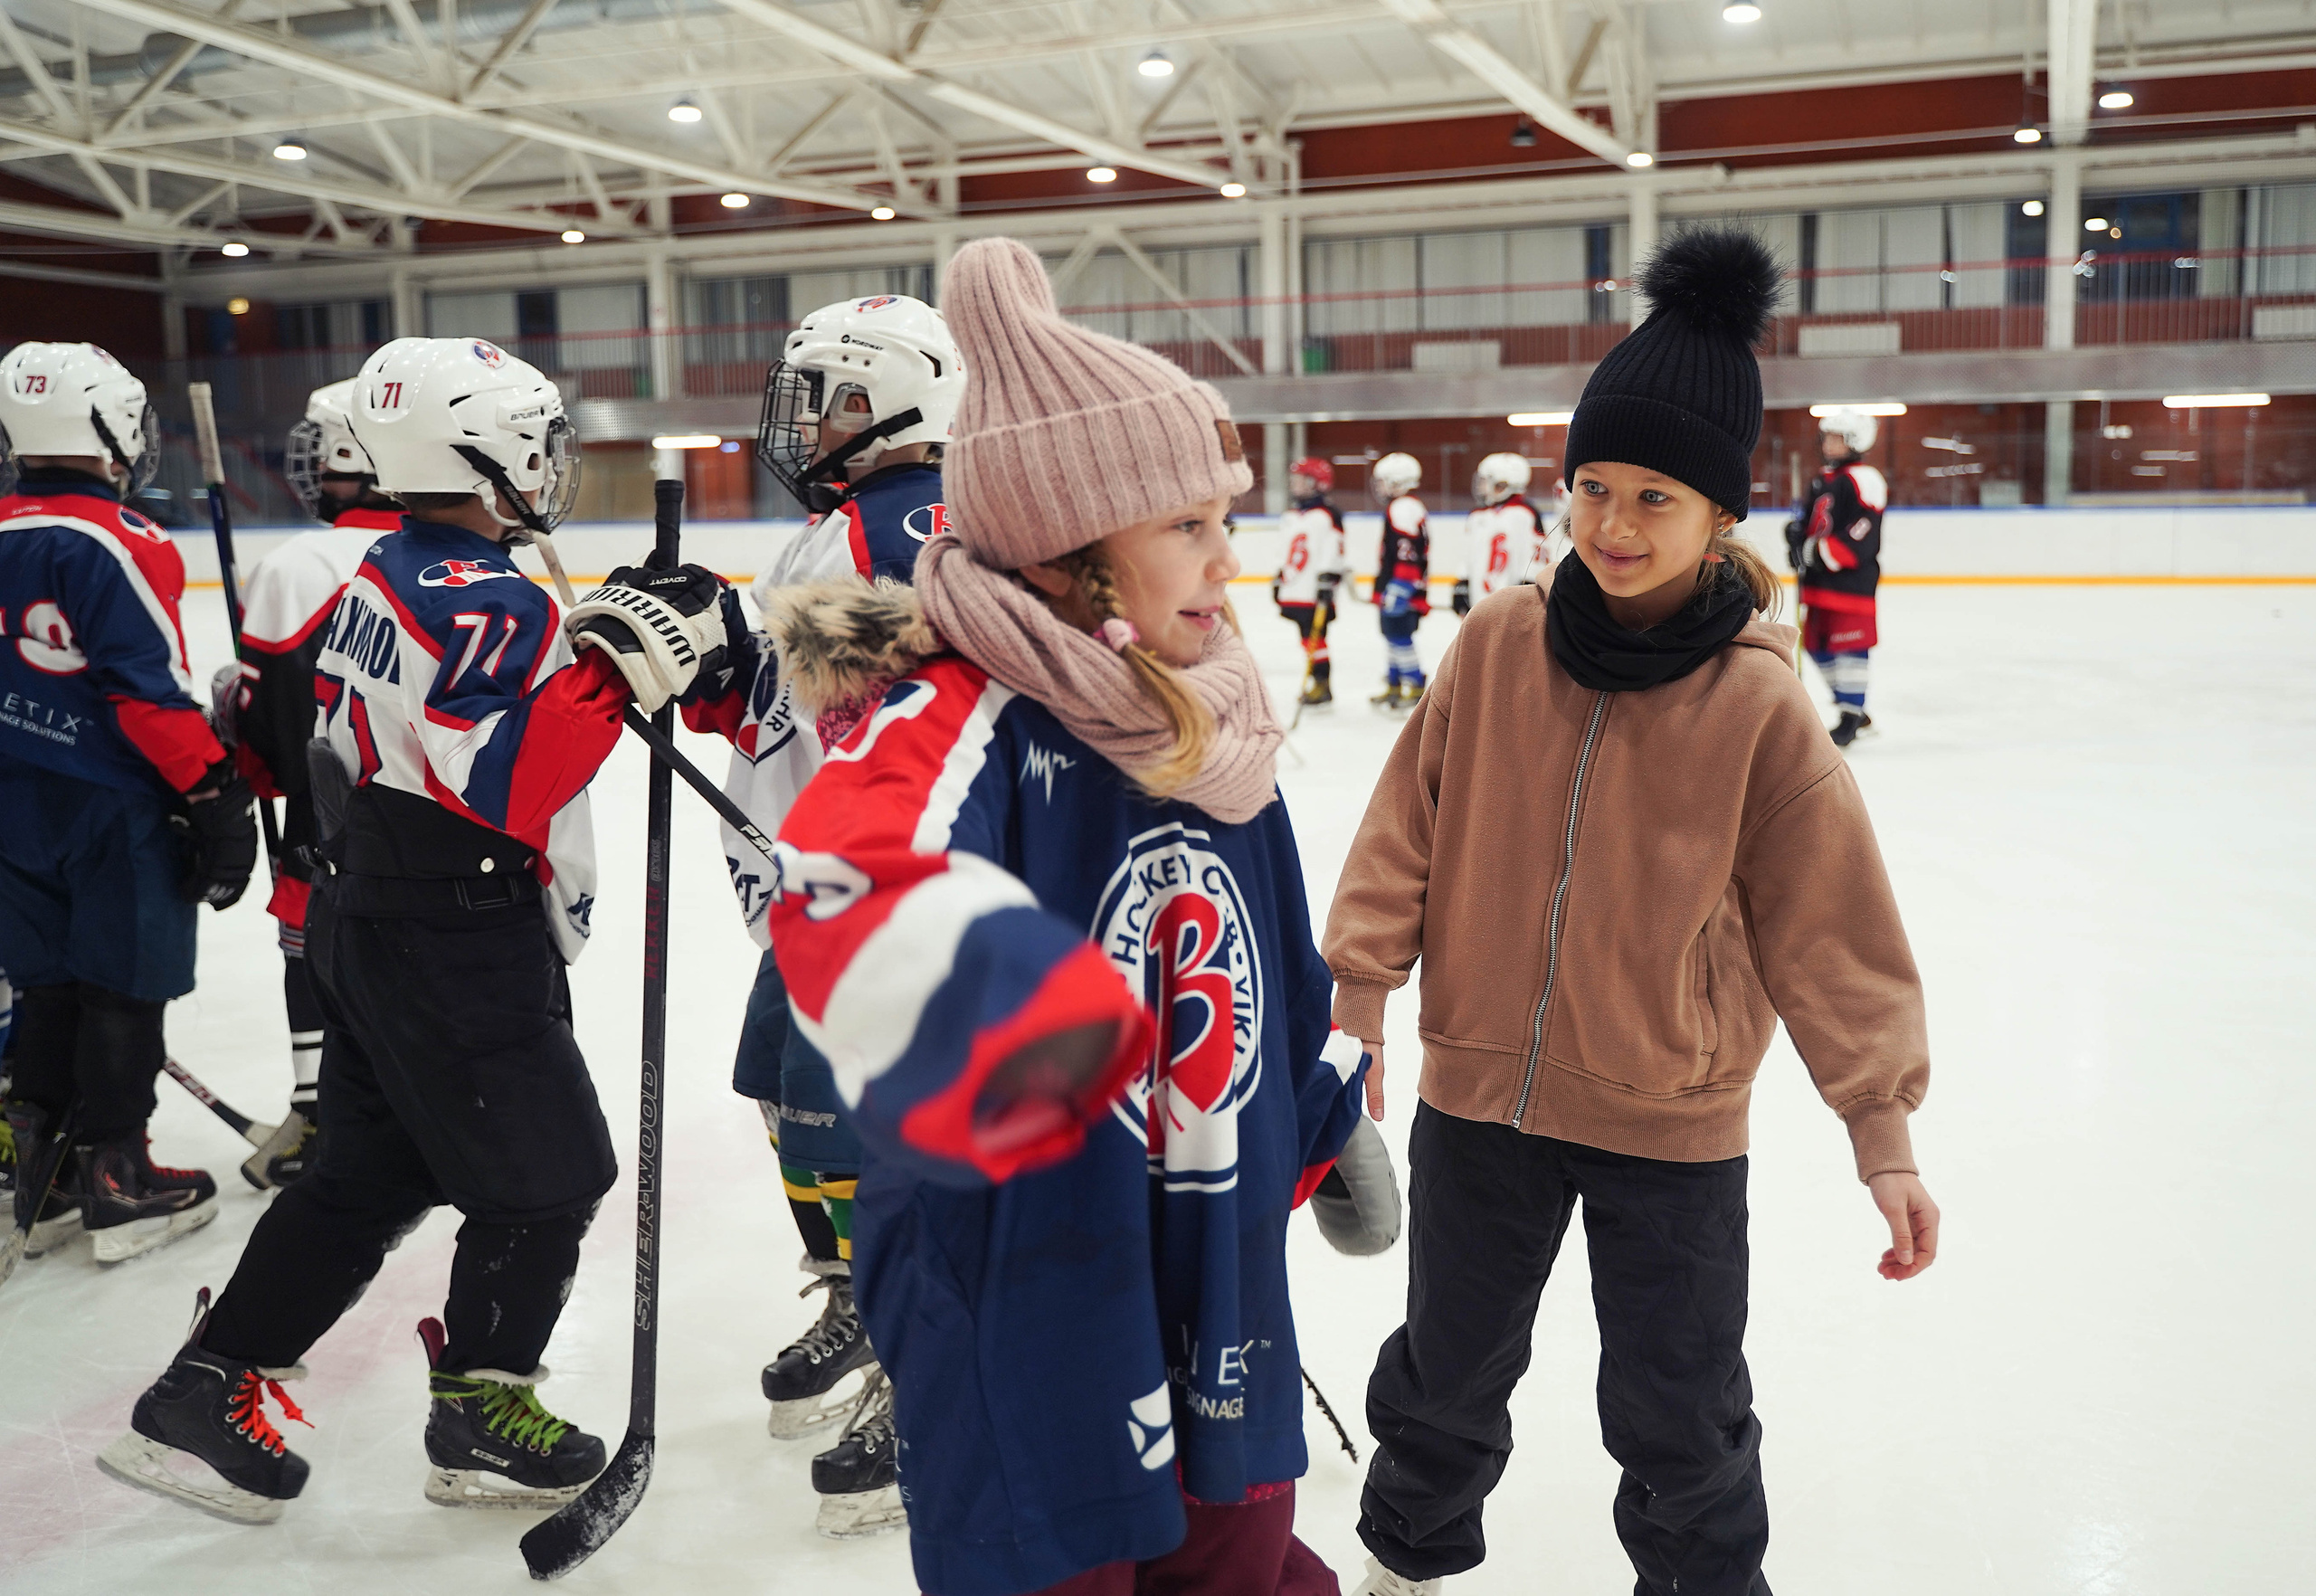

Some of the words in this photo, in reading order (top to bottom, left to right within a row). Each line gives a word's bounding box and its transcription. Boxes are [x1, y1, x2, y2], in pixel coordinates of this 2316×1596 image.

[25, 375, 46, 394] 73
[382, 382, 403, 409] 71
[649, 575, 688, 586] COVERT
[445, 611, 520, 694] 71
[22, 717, 77, 747] SOLUTIONS
